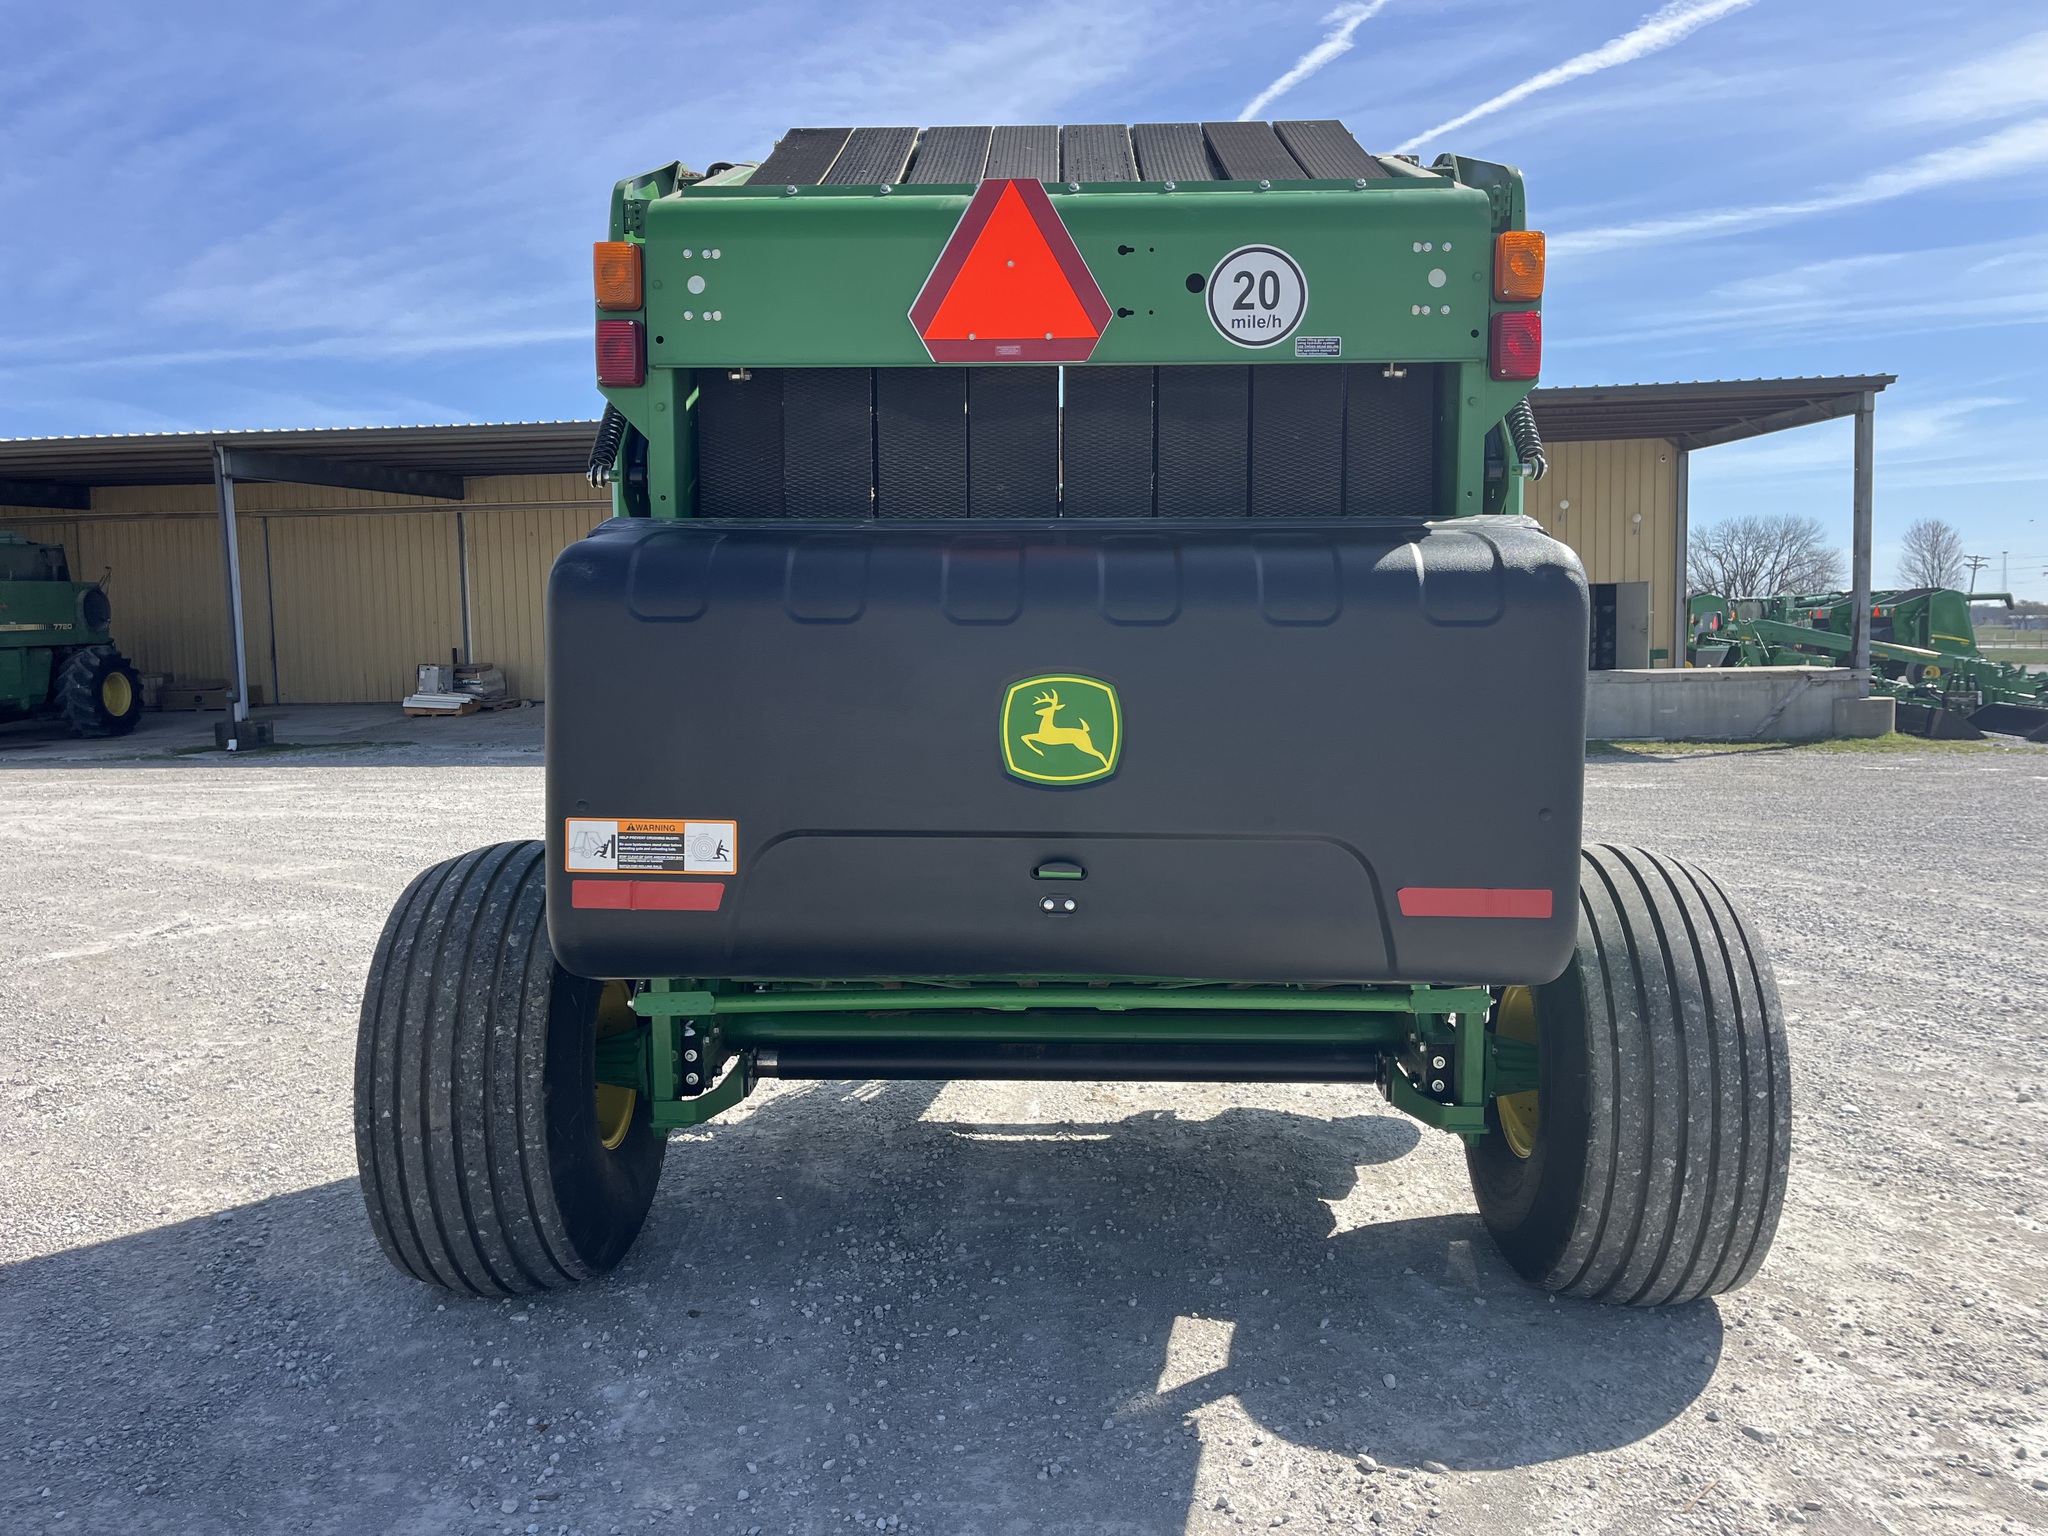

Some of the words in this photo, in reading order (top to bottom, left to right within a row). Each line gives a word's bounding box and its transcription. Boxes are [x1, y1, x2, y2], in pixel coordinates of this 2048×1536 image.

[1232, 270, 1281, 311] 20
[1231, 314, 1282, 329] mile/h
[635, 824, 676, 832] WARNING
